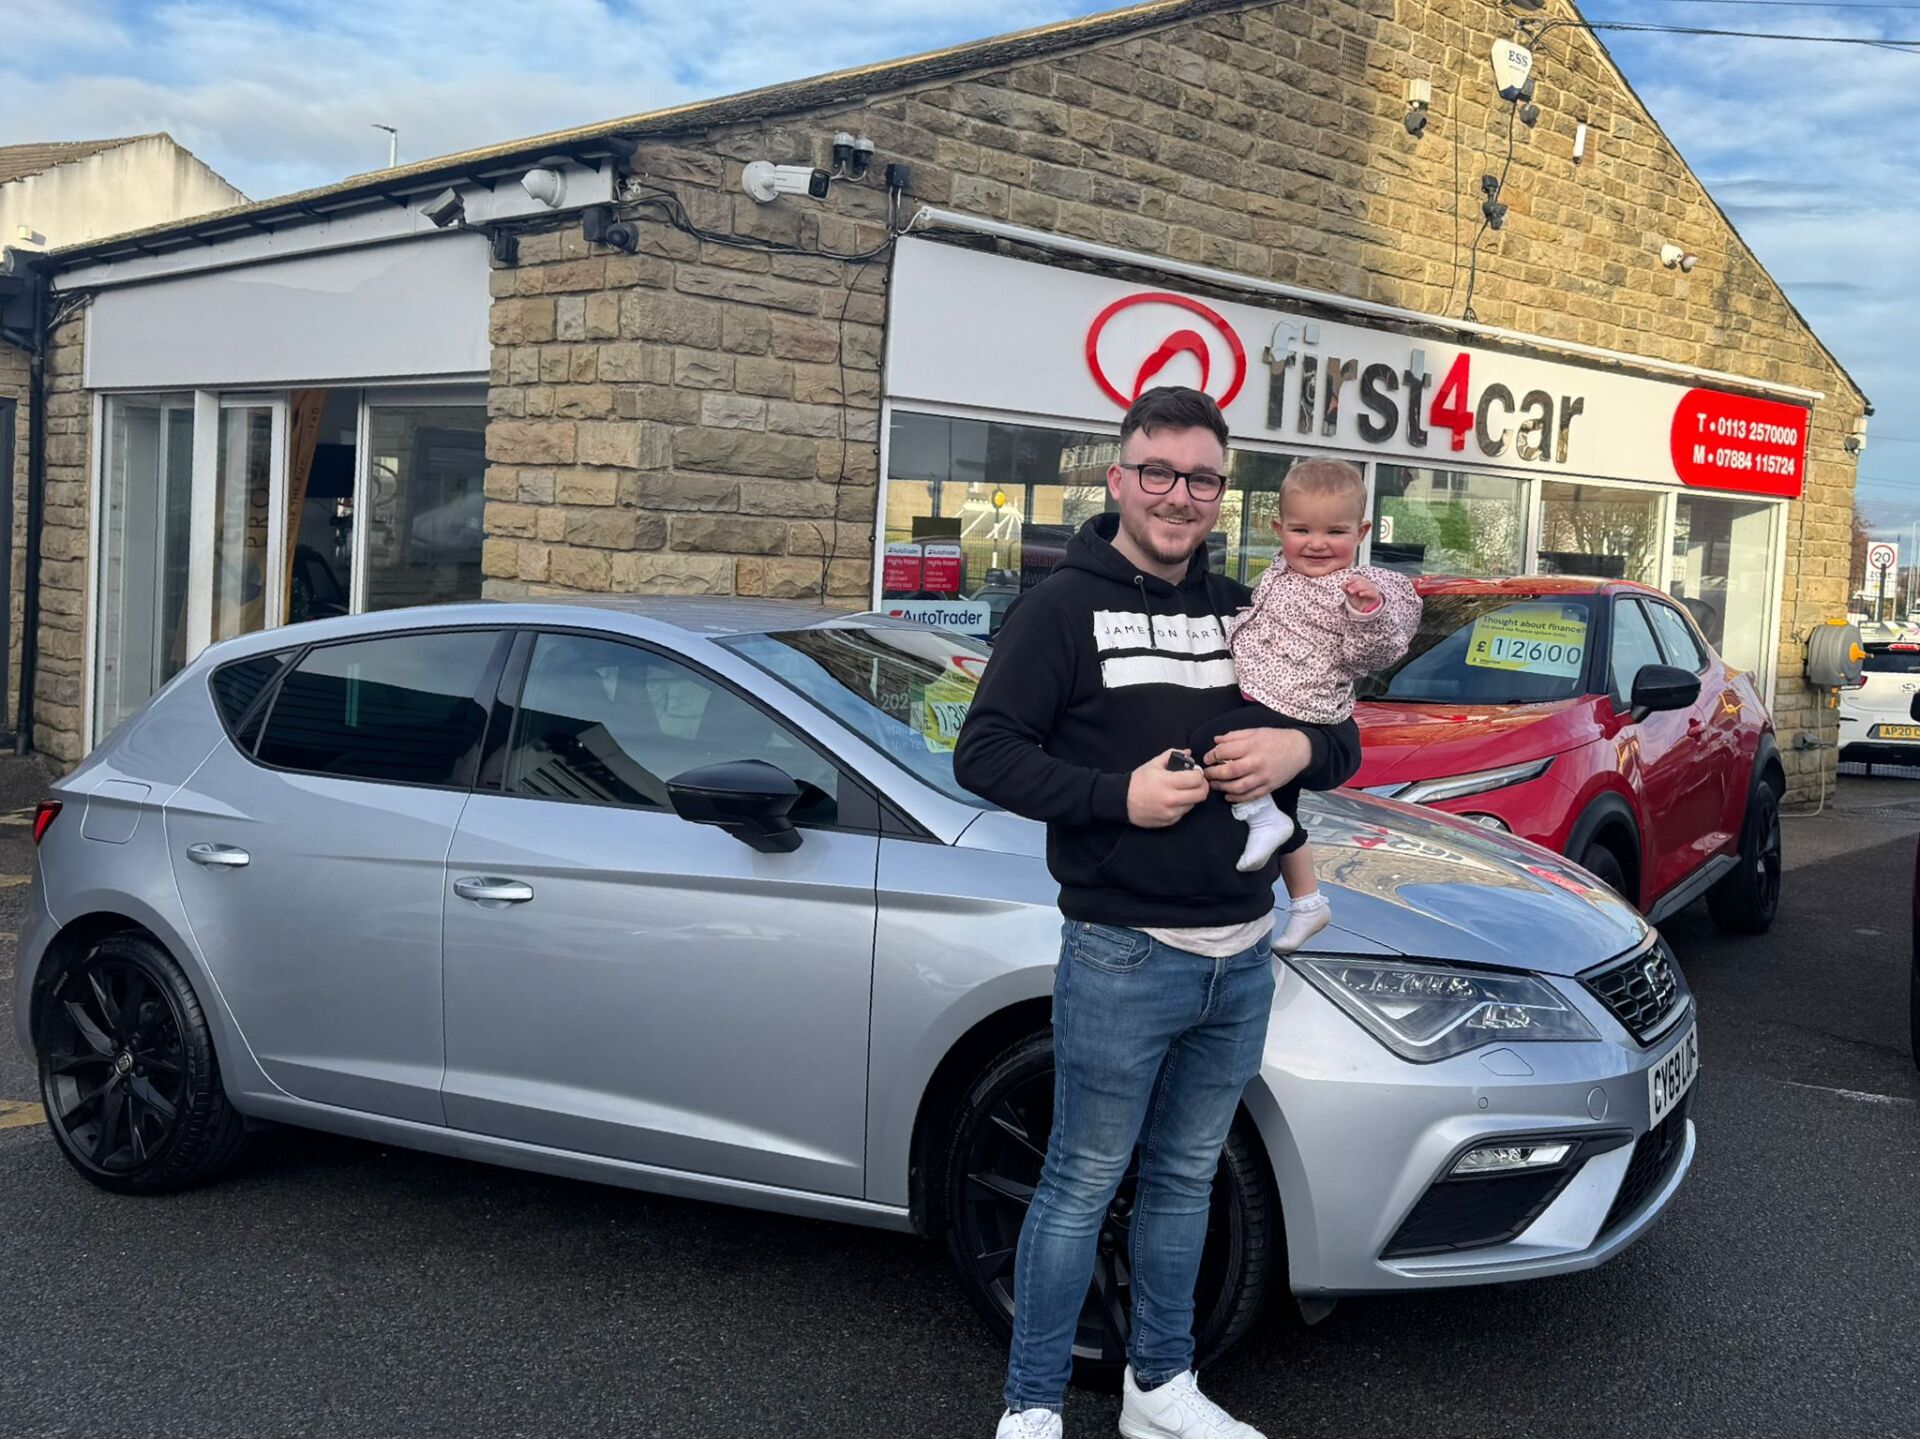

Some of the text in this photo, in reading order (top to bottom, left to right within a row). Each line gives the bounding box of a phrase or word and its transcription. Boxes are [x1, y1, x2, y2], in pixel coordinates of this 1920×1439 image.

[1508, 50, 1528, 67] ESS
[1262, 318, 1585, 464] first4car
[1696, 412, 1798, 446] T 0113 2570000
[1692, 444, 1795, 476] M 07884 115724
[1873, 551, 1891, 563] 20
[1869, 571, 1893, 579] ZOE
[903, 610, 982, 625] AutoTrader
[1483, 616, 1586, 634] Thought about finance?
[1104, 625, 1177, 638] JAMEON
[1476, 638, 1582, 665] £ 12600
[1884, 727, 1912, 736] AP20
[1654, 1051, 1681, 1115] CY69
